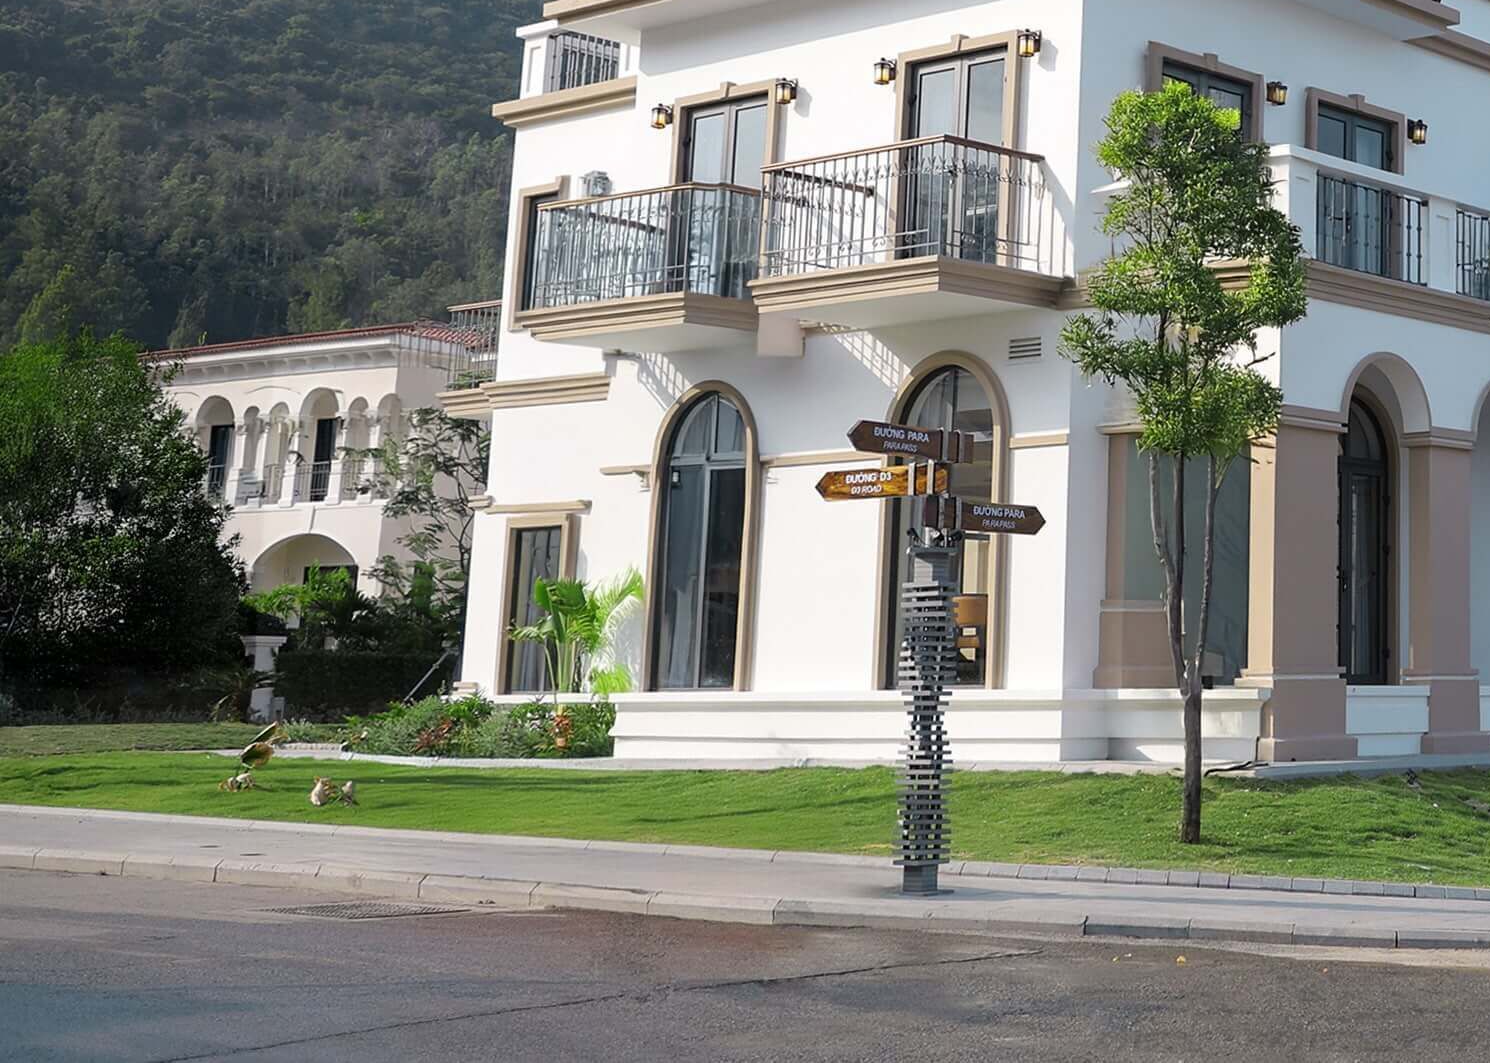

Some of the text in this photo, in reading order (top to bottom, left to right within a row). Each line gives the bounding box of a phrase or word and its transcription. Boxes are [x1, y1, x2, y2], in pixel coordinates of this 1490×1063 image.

[907, 431, 930, 443] PARA
[861, 485, 882, 494] ROAD
[1003, 508, 1026, 519] PARA
